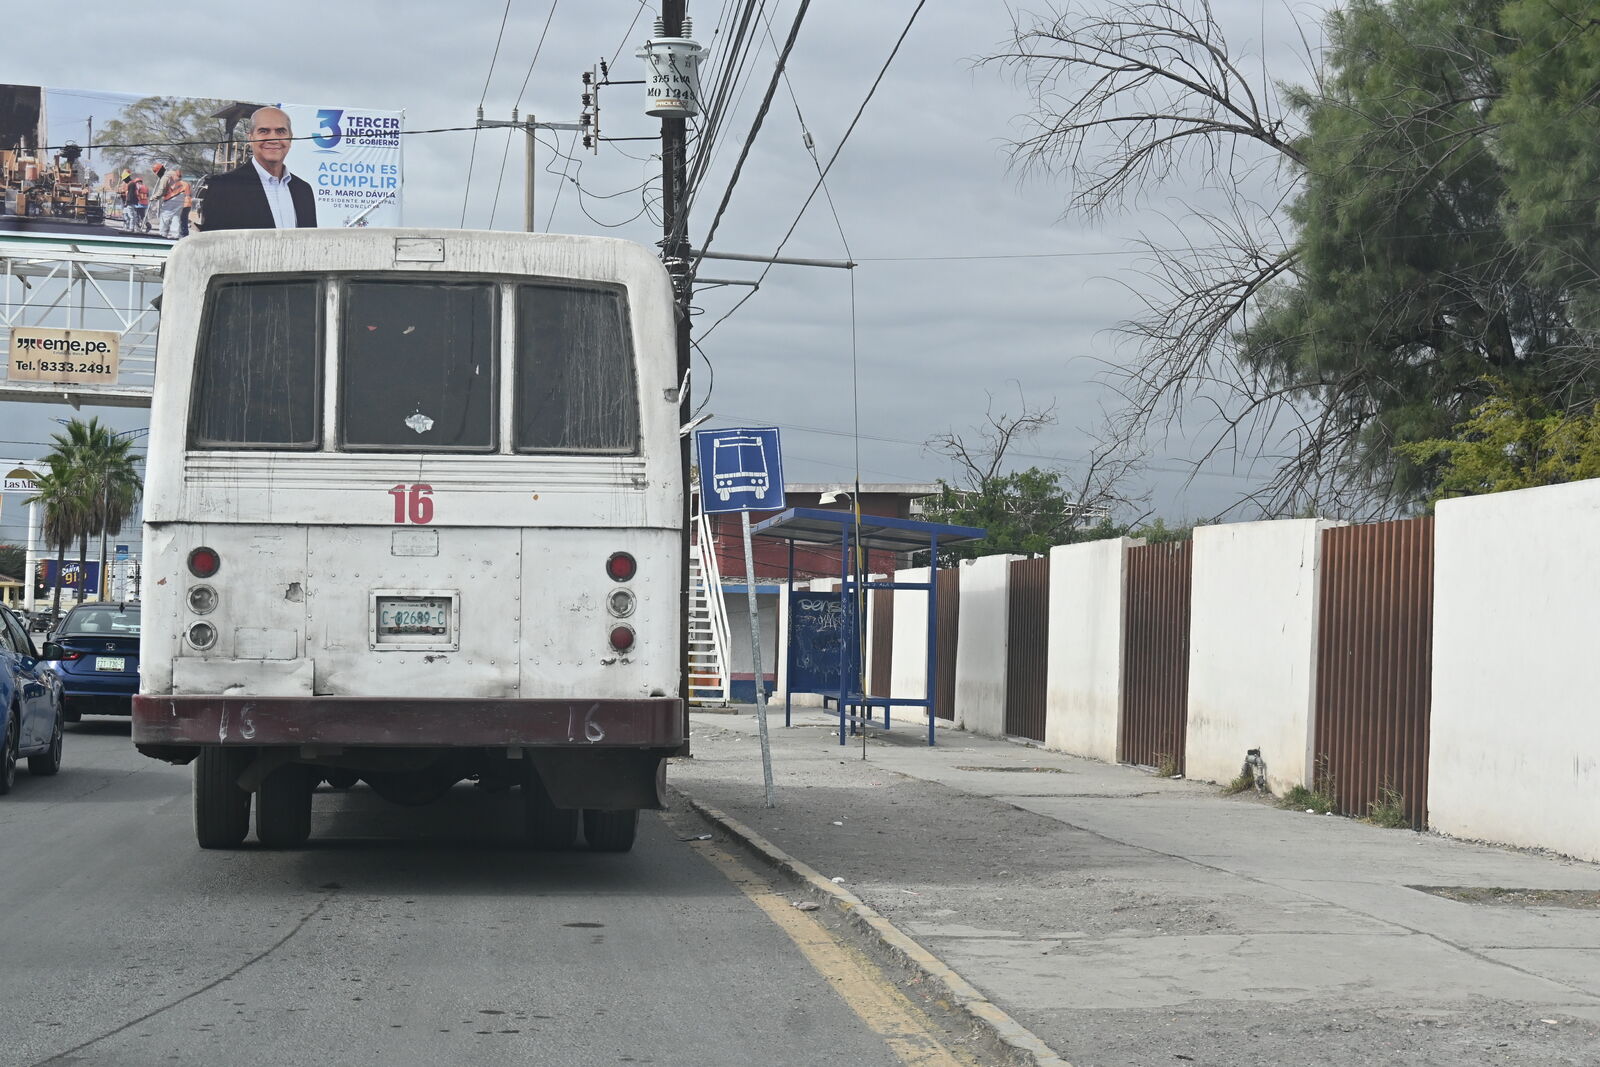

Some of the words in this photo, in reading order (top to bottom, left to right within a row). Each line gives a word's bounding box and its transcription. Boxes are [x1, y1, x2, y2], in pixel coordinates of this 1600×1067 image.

[311, 110, 344, 149] 3
[347, 117, 399, 129] TERCER
[346, 128, 400, 139] INFORME
[359, 138, 399, 146] GOBIERNO
[318, 161, 375, 174] ACCIÓN
[381, 164, 397, 175] ES
[318, 174, 397, 189] CUMPLIR
[366, 189, 396, 198] DÁVILA
[16, 360, 36, 370] Tel.
[40, 361, 111, 374] 8333.2491
[4, 480, 20, 488] Las
[21, 480, 40, 489] Mis
[388, 484, 434, 524] 16
